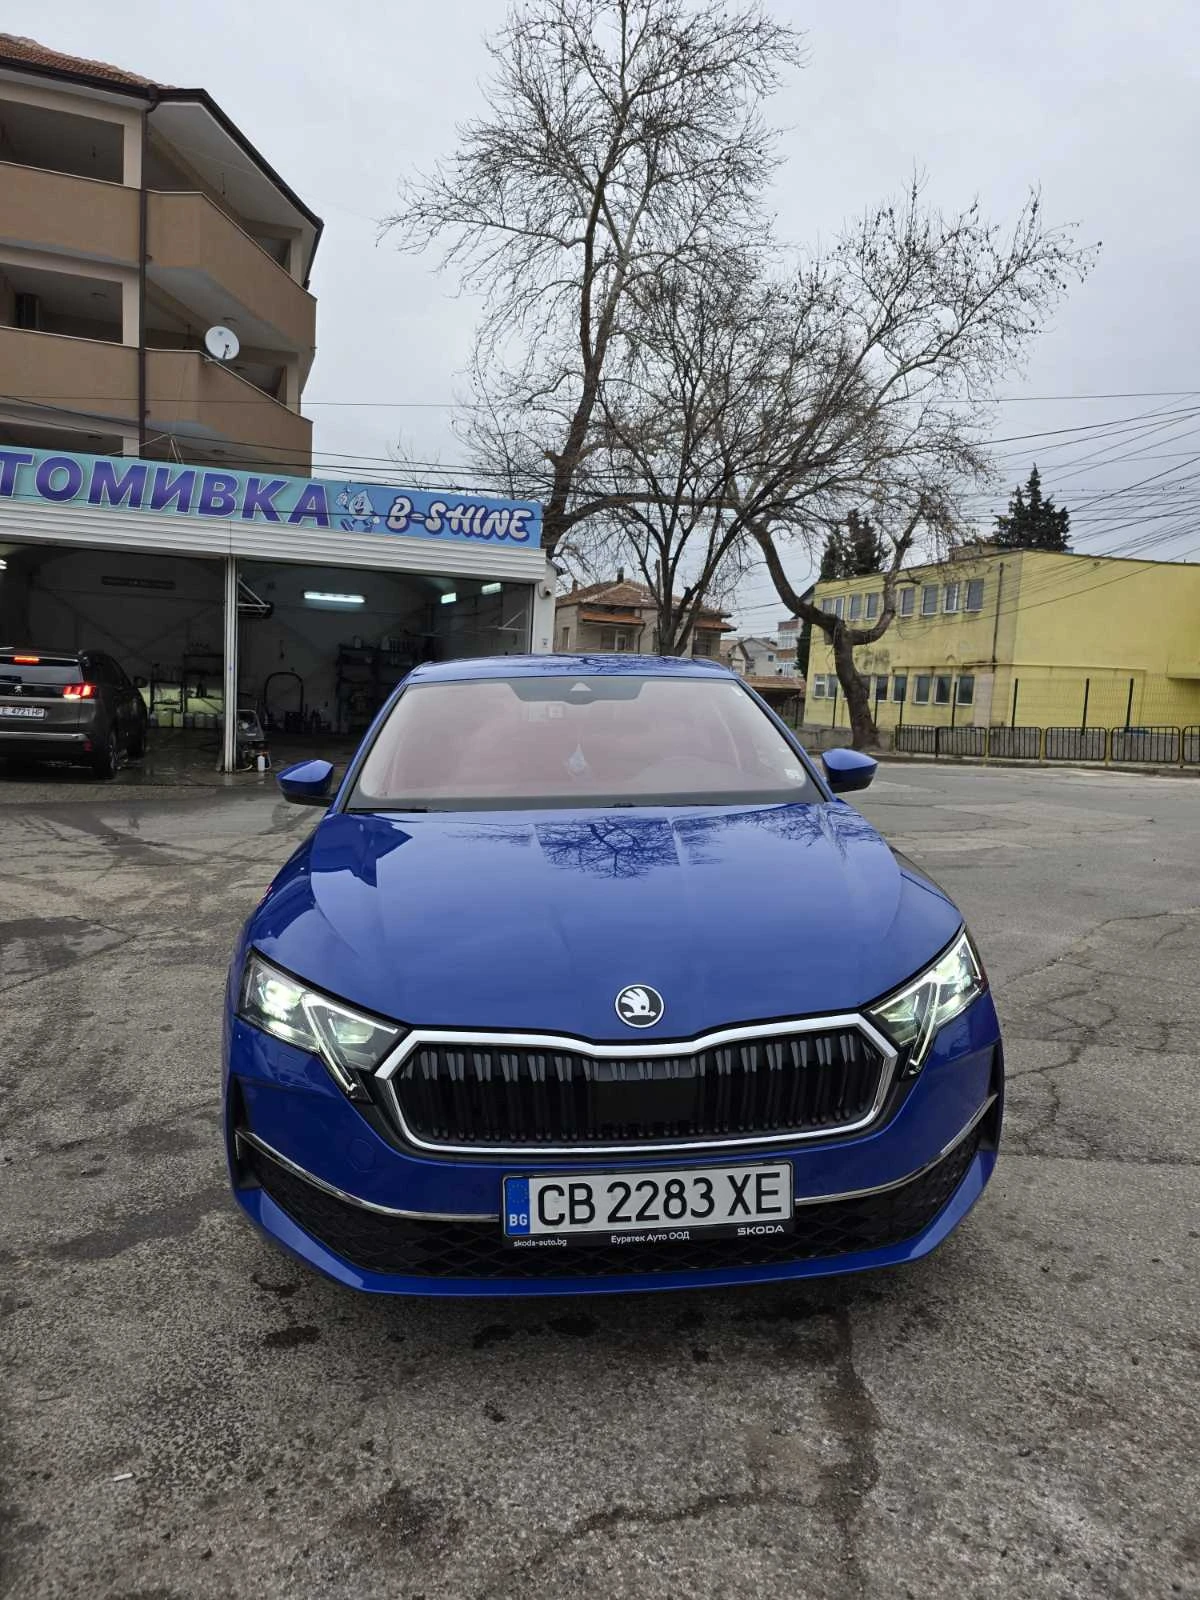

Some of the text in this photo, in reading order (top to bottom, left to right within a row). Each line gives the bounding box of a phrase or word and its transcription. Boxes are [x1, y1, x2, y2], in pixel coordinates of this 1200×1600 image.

[0, 451, 331, 528] ТОМИВКА
[386, 496, 534, 542] B-SHINE
[537, 1171, 783, 1226] CB 2283 XE
[509, 1214, 528, 1226] BG
[737, 1224, 785, 1236] SKODA
[513, 1238, 567, 1248] skoda-auto.bg
[611, 1231, 690, 1244] Еуратек Ауто ООД
